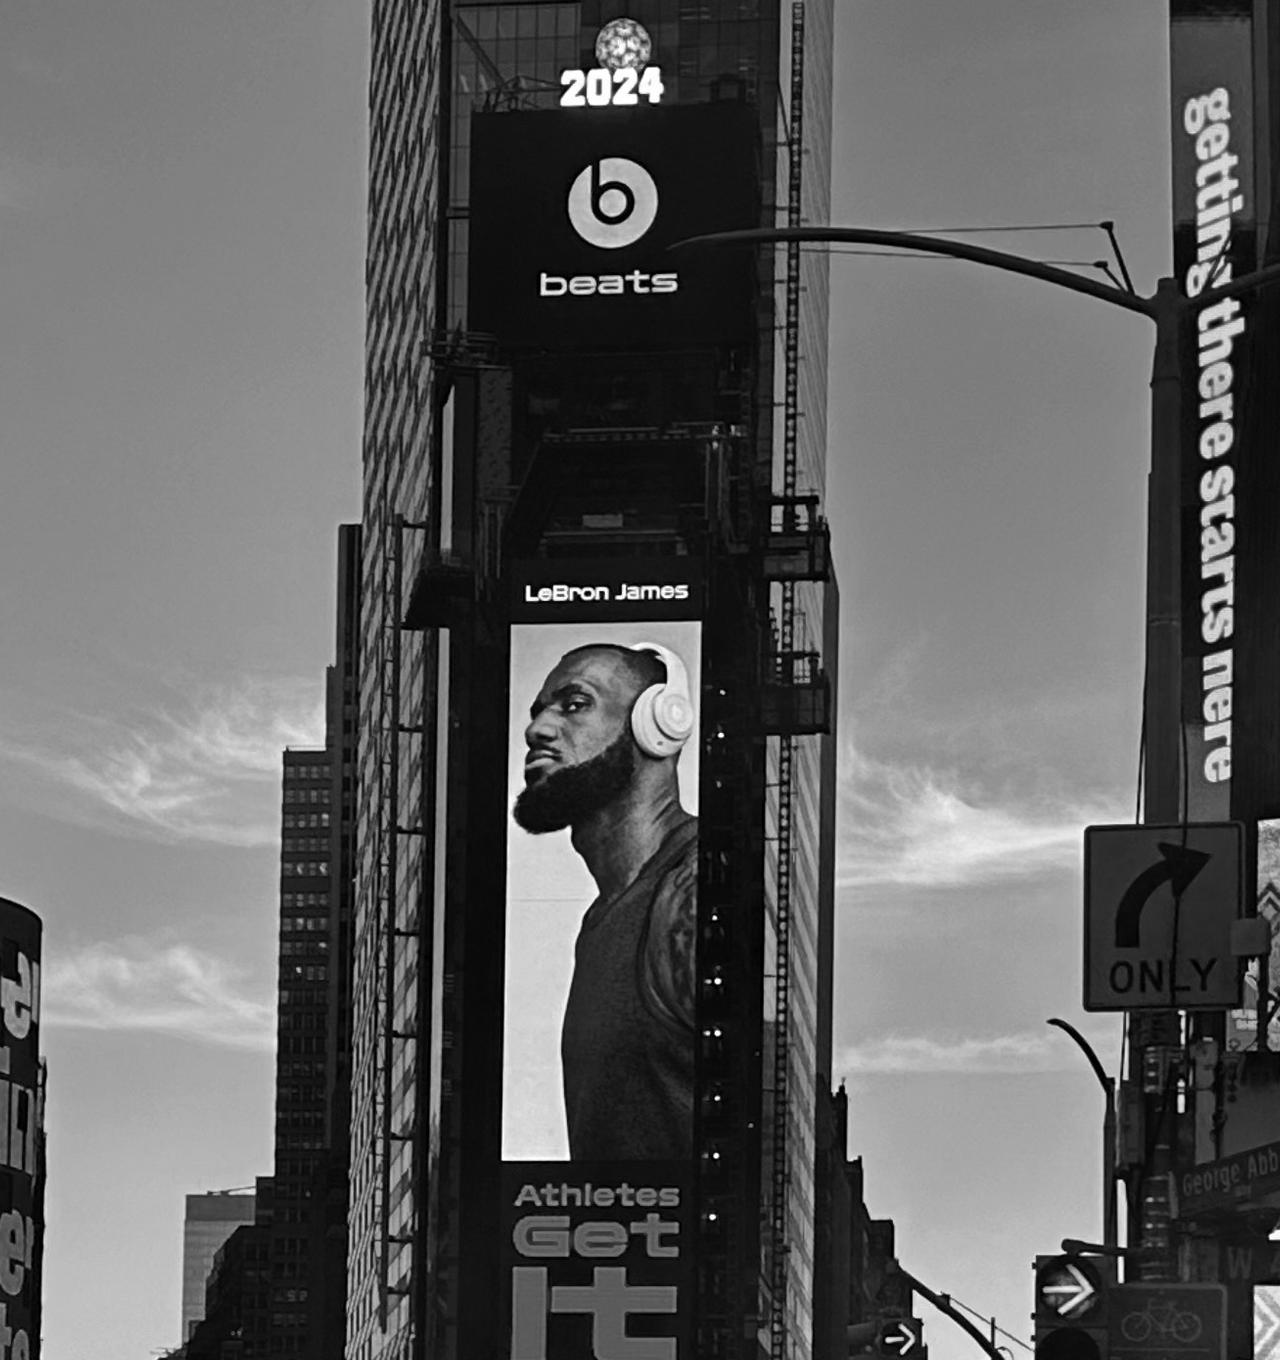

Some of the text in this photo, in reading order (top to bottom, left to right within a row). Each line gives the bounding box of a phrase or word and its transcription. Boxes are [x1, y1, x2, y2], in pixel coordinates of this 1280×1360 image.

[560, 68, 664, 106] 2024
[1184, 86, 1245, 301] getting
[539, 268, 679, 297] beats
[1196, 296, 1245, 460] there
[1197, 463, 1235, 645] starts
[524, 581, 689, 603] LeBron James
[1110, 957, 1218, 994] ONLY
[513, 1182, 681, 1207] Athletes
[1183, 1161, 1240, 1197] George
[512, 1213, 680, 1258] Get
[1228, 1247, 1253, 1280] W
